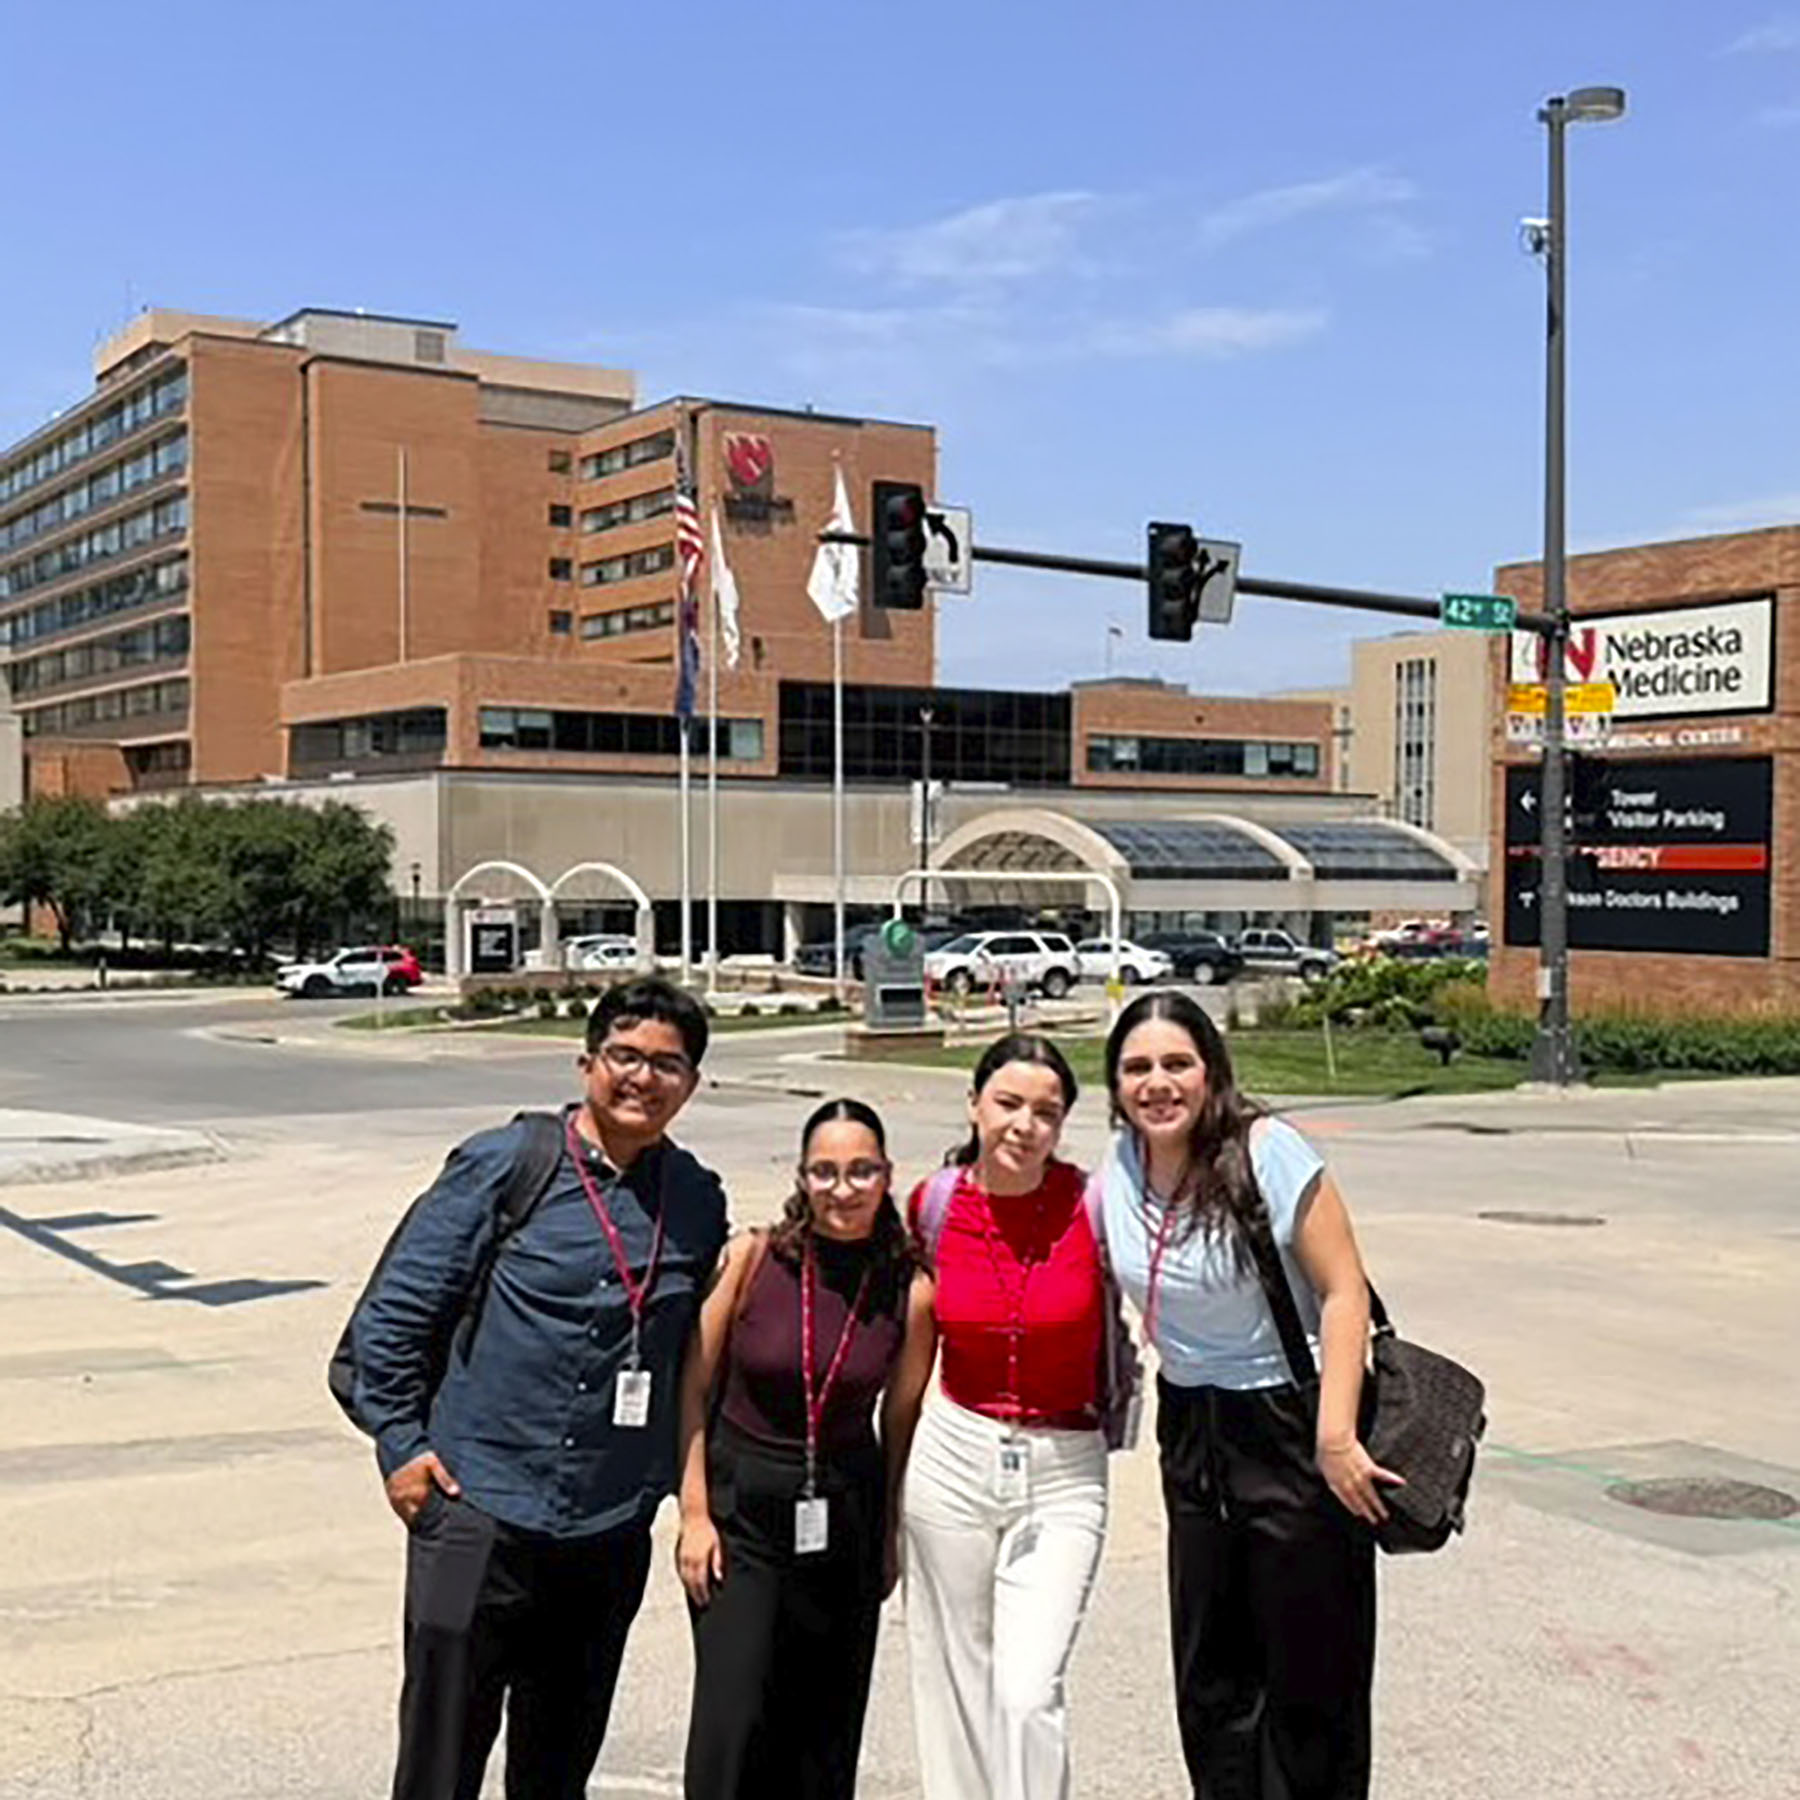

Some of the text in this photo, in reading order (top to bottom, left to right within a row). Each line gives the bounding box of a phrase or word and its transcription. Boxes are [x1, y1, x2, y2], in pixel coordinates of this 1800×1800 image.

[1605, 625, 1742, 663] Nebraska
[1607, 663, 1742, 699] Medicine
[1663, 809, 1725, 831] Parking
